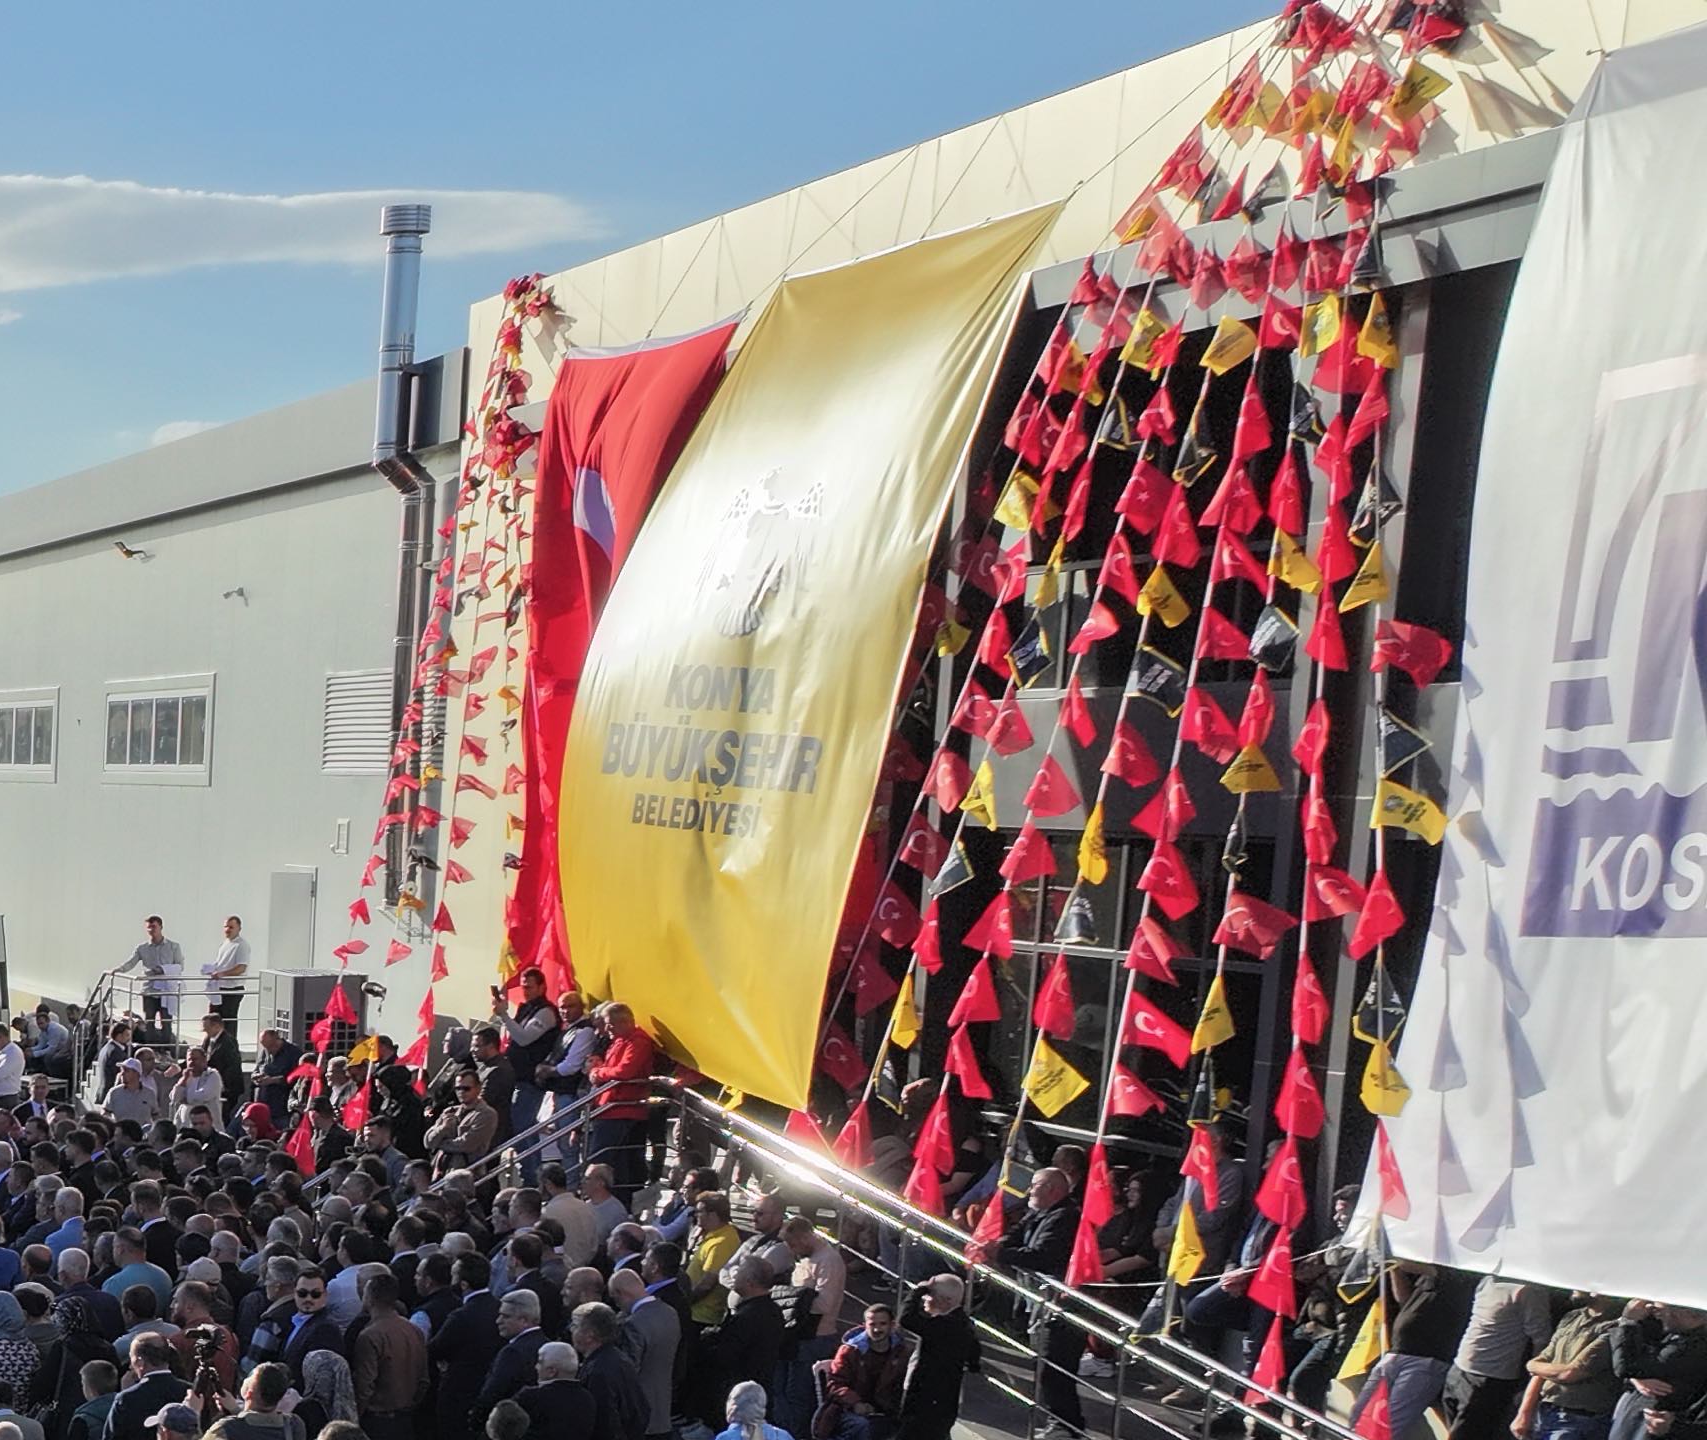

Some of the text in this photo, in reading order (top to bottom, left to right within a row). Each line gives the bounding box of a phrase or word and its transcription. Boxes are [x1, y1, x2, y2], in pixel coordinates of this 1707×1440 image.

[664, 664, 776, 714] KONYA
[601, 712, 823, 795] BÜYÜKŞEHİR
[632, 791, 763, 838] BELEDİYESİ
[1570, 832, 1706, 911] KOS
